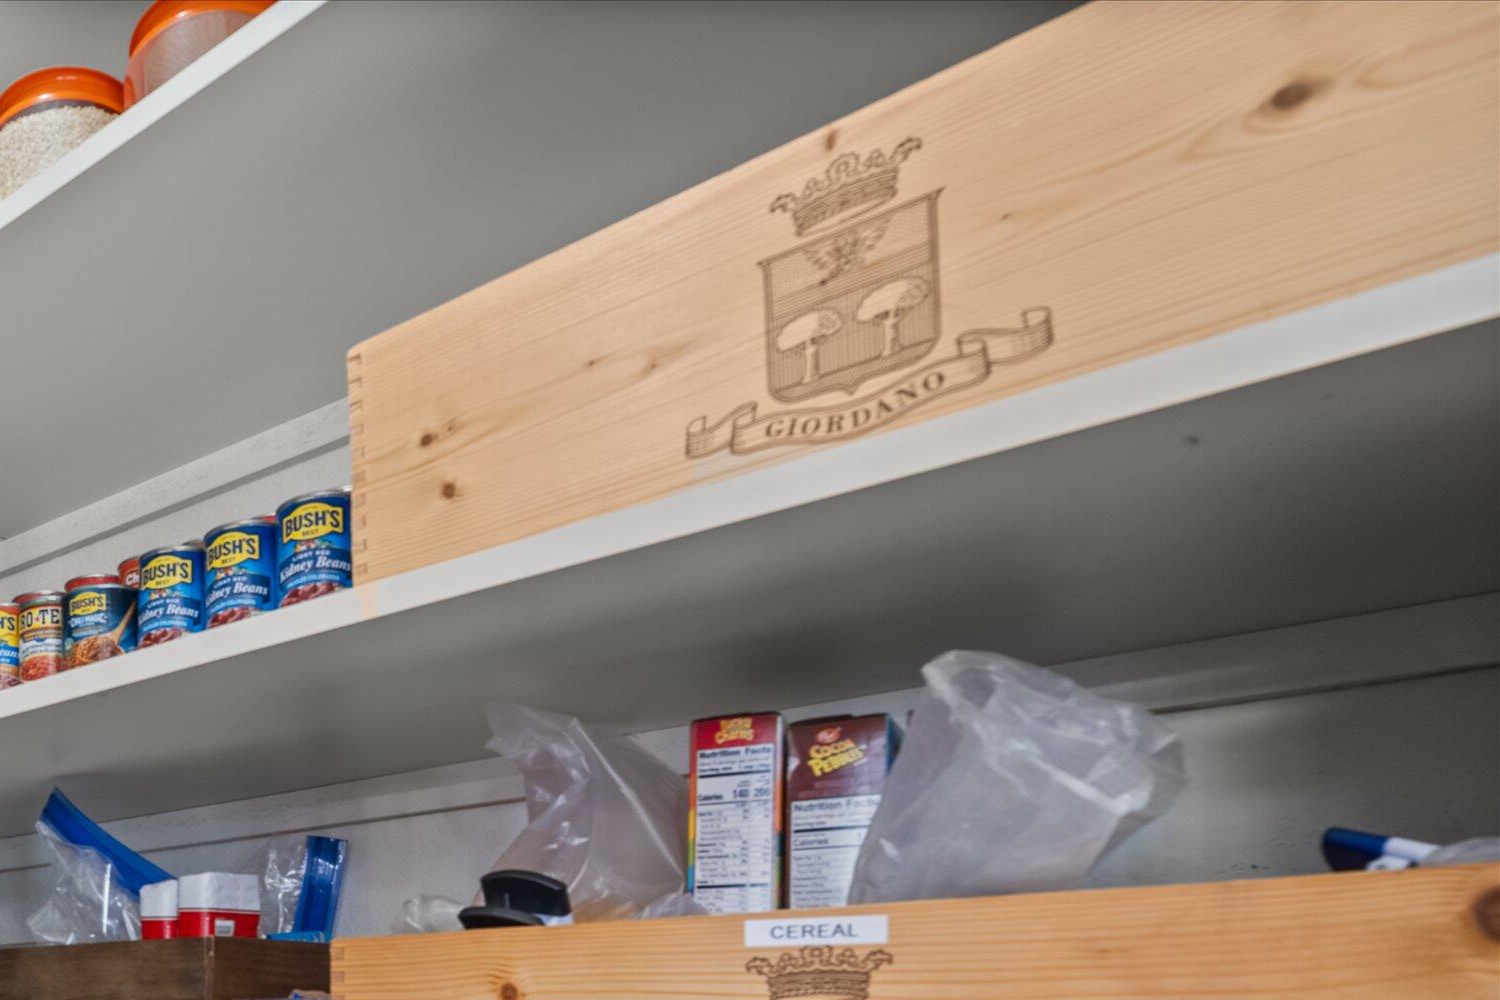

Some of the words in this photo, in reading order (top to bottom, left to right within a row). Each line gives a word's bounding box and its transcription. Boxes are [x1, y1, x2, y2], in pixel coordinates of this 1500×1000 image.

[764, 370, 946, 440] GIORDANO
[284, 508, 340, 538] BUSH'S
[208, 537, 257, 563] BUSH'S
[316, 556, 352, 572] Beans
[141, 561, 189, 586] BUSH'S
[232, 580, 268, 597] Beans
[70, 596, 105, 612] BUSH'S
[165, 603, 199, 619] Beans
[770, 923, 859, 940] CEREAL
